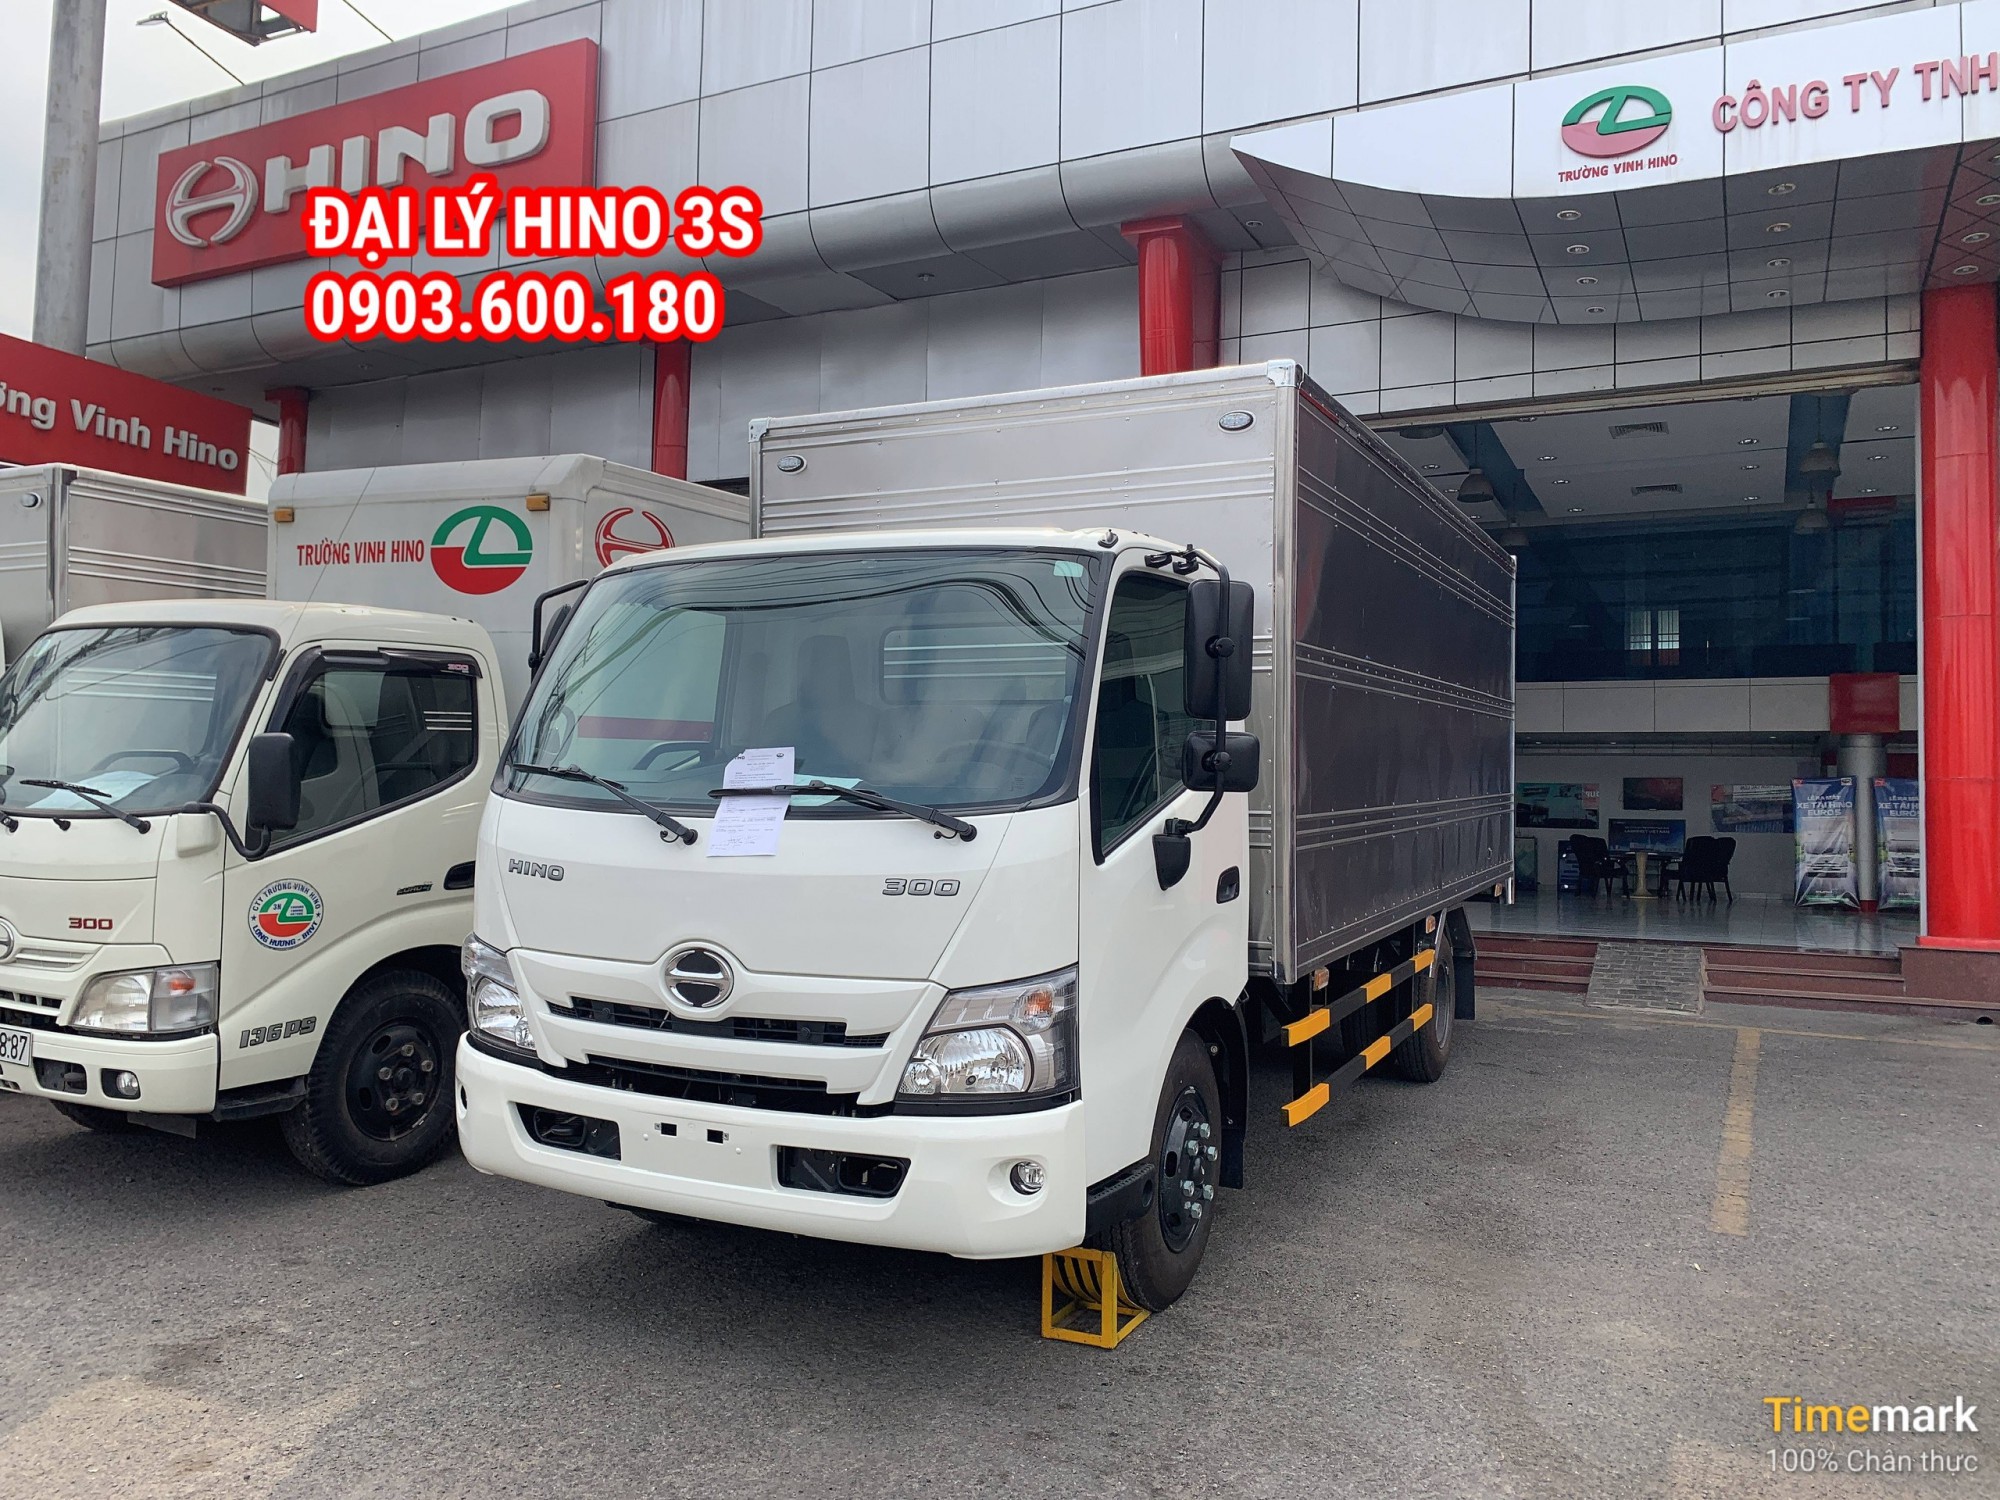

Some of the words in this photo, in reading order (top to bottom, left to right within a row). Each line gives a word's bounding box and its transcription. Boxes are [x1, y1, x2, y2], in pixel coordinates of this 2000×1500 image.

[1712, 79, 1829, 133] CÔNG
[1843, 67, 1900, 112] TY
[1914, 51, 1998, 101] TNH
[264, 89, 550, 213] HINO
[1558, 165, 1609, 182] TRƯỜNG
[1614, 159, 1643, 174] VINH
[1648, 154, 1678, 169] HINO
[70, 399, 150, 449] Vinh
[163, 426, 238, 470] Hino
[297, 537, 350, 566] TRƯỜNG
[355, 541, 386, 564] VINH
[391, 539, 425, 563] HINO
[508, 858, 564, 881] HINO
[882, 878, 960, 896] 300
[68, 917, 113, 930] 300
[252, 925, 269, 943] LONG
[239, 1016, 317, 1049] 136PS
